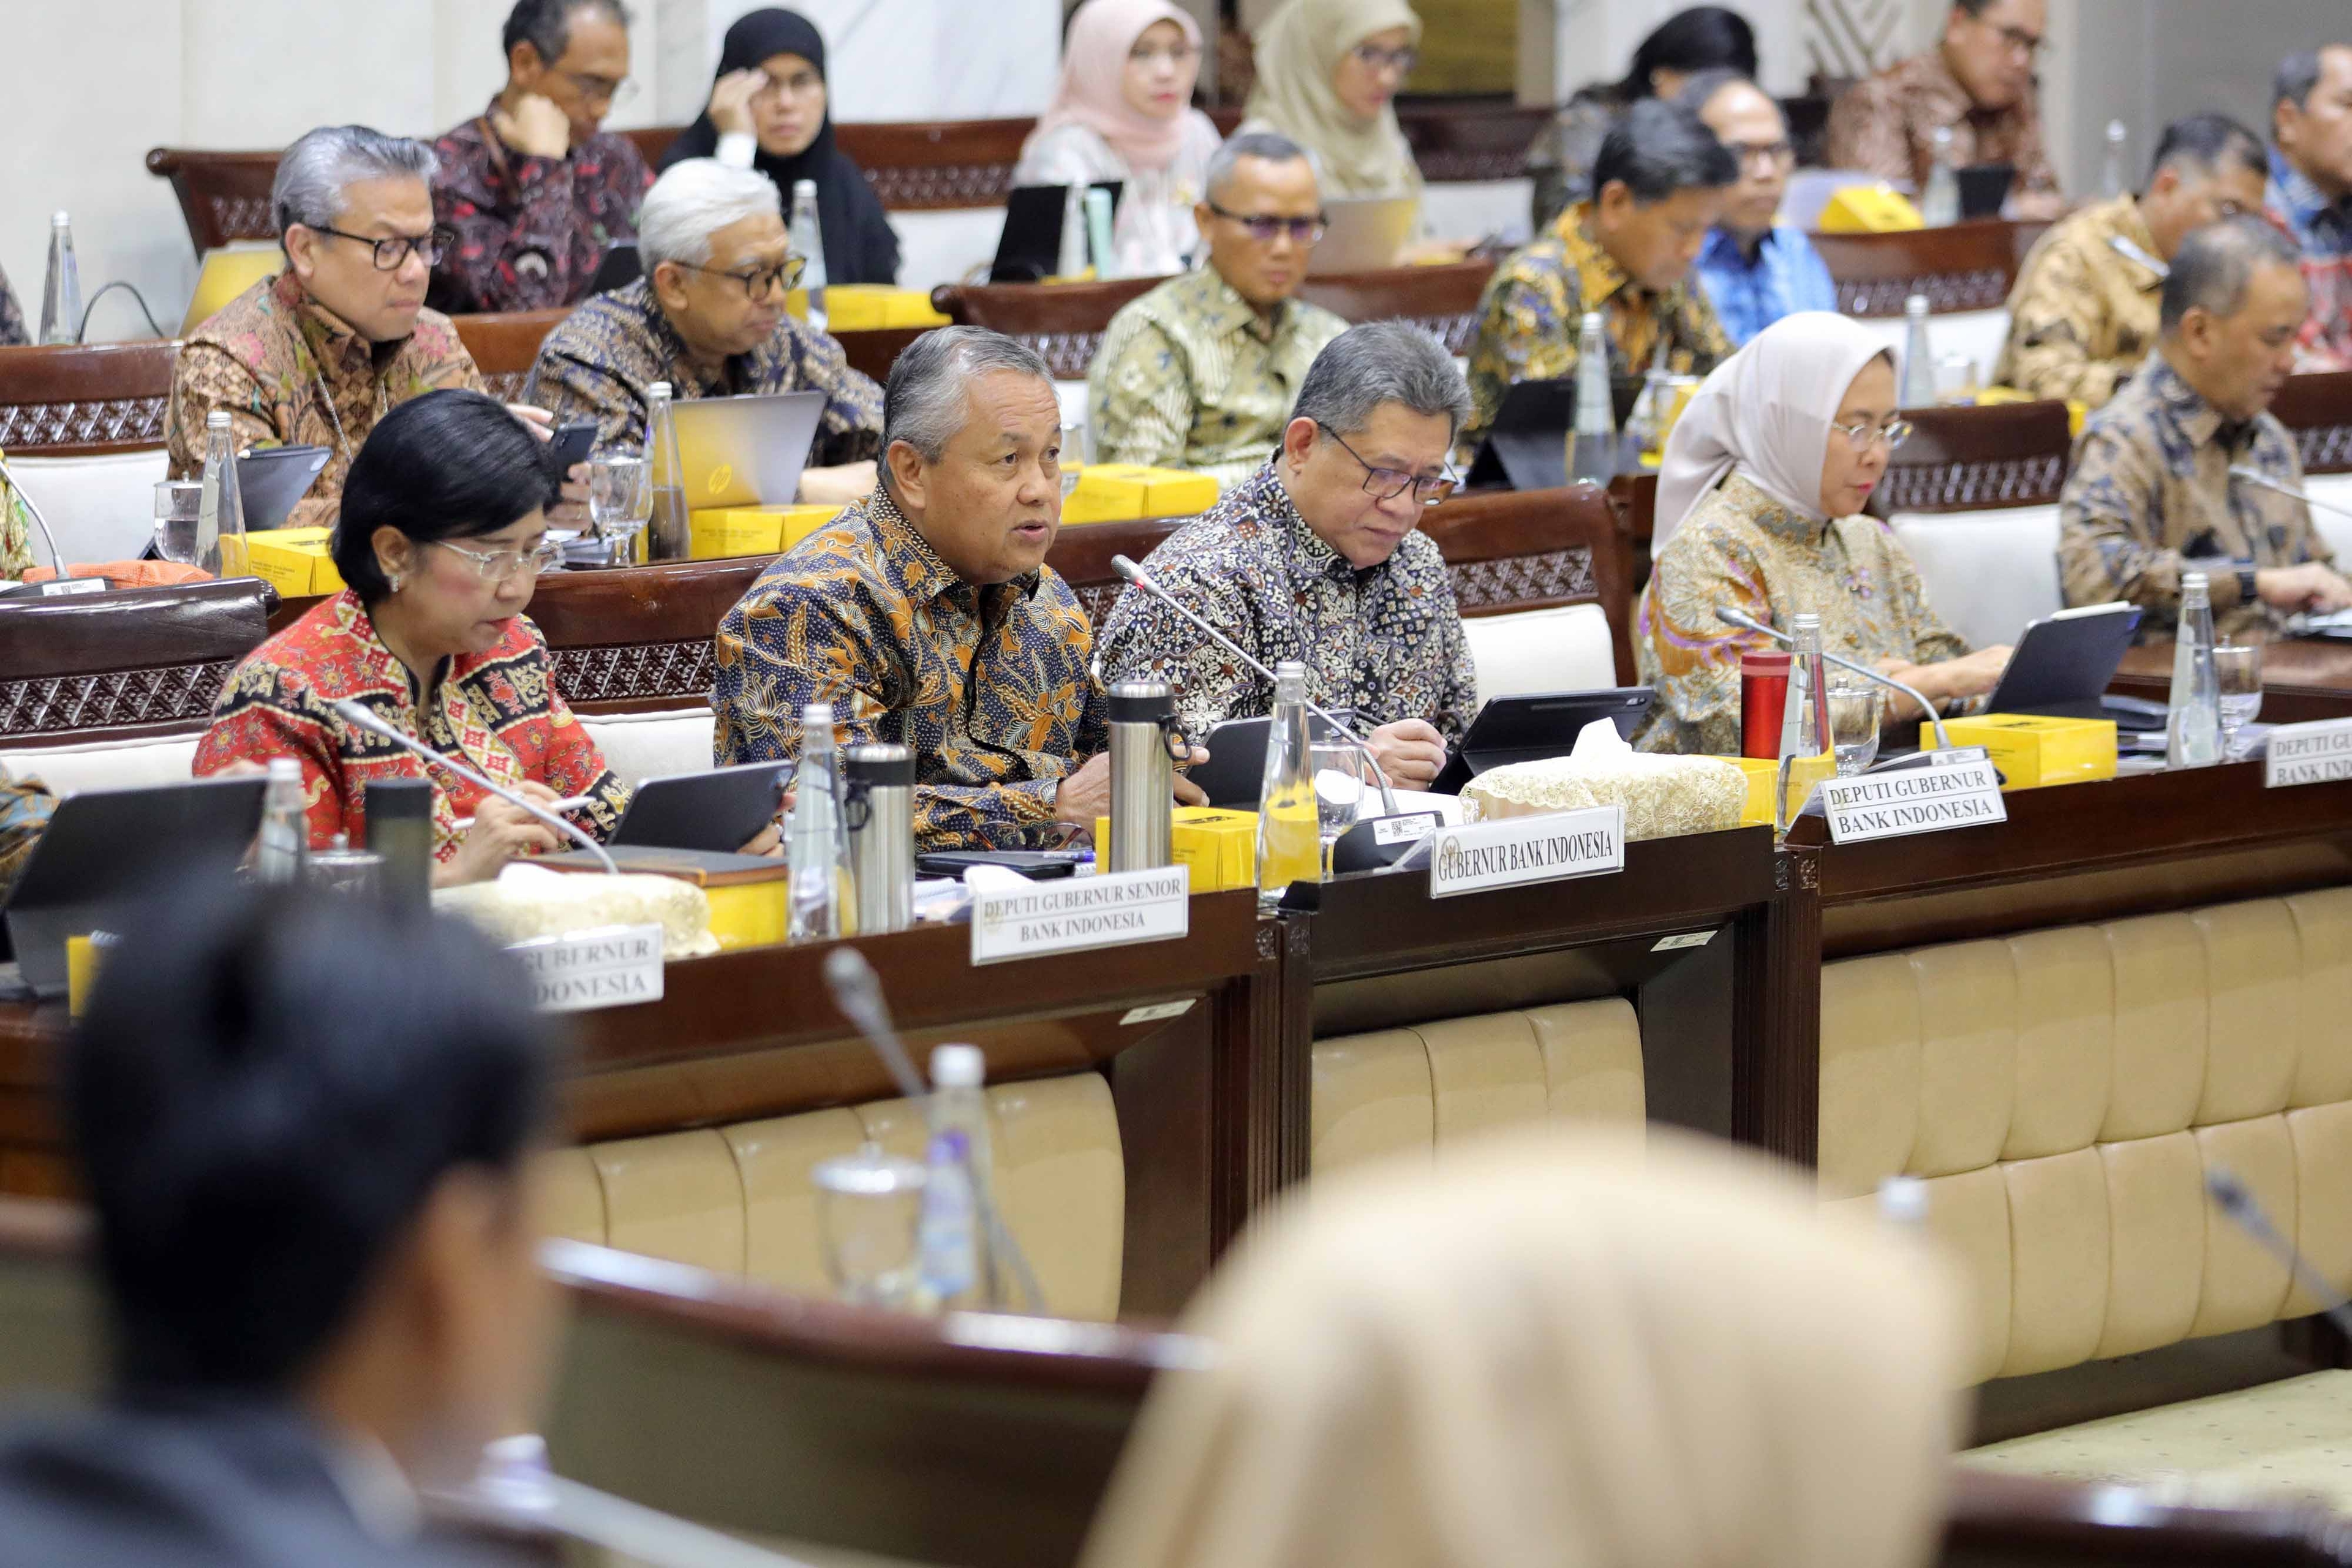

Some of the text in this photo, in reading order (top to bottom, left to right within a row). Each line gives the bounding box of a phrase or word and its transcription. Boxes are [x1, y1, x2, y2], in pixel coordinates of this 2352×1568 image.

[2277, 736, 2328, 756] DEPUTI
[1828, 771, 1986, 805] DEPUTI GUBERNUR
[2277, 763, 2321, 783] BANK
[1837, 799, 1994, 834] BANK INDONESIA
[1439, 830, 1613, 881] GUBERNUR BANK INDONESIA
[984, 878, 1181, 918] DEPUTI GUBERNUR SENIOR
[1020, 912, 1145, 942] BANK INDONESIA
